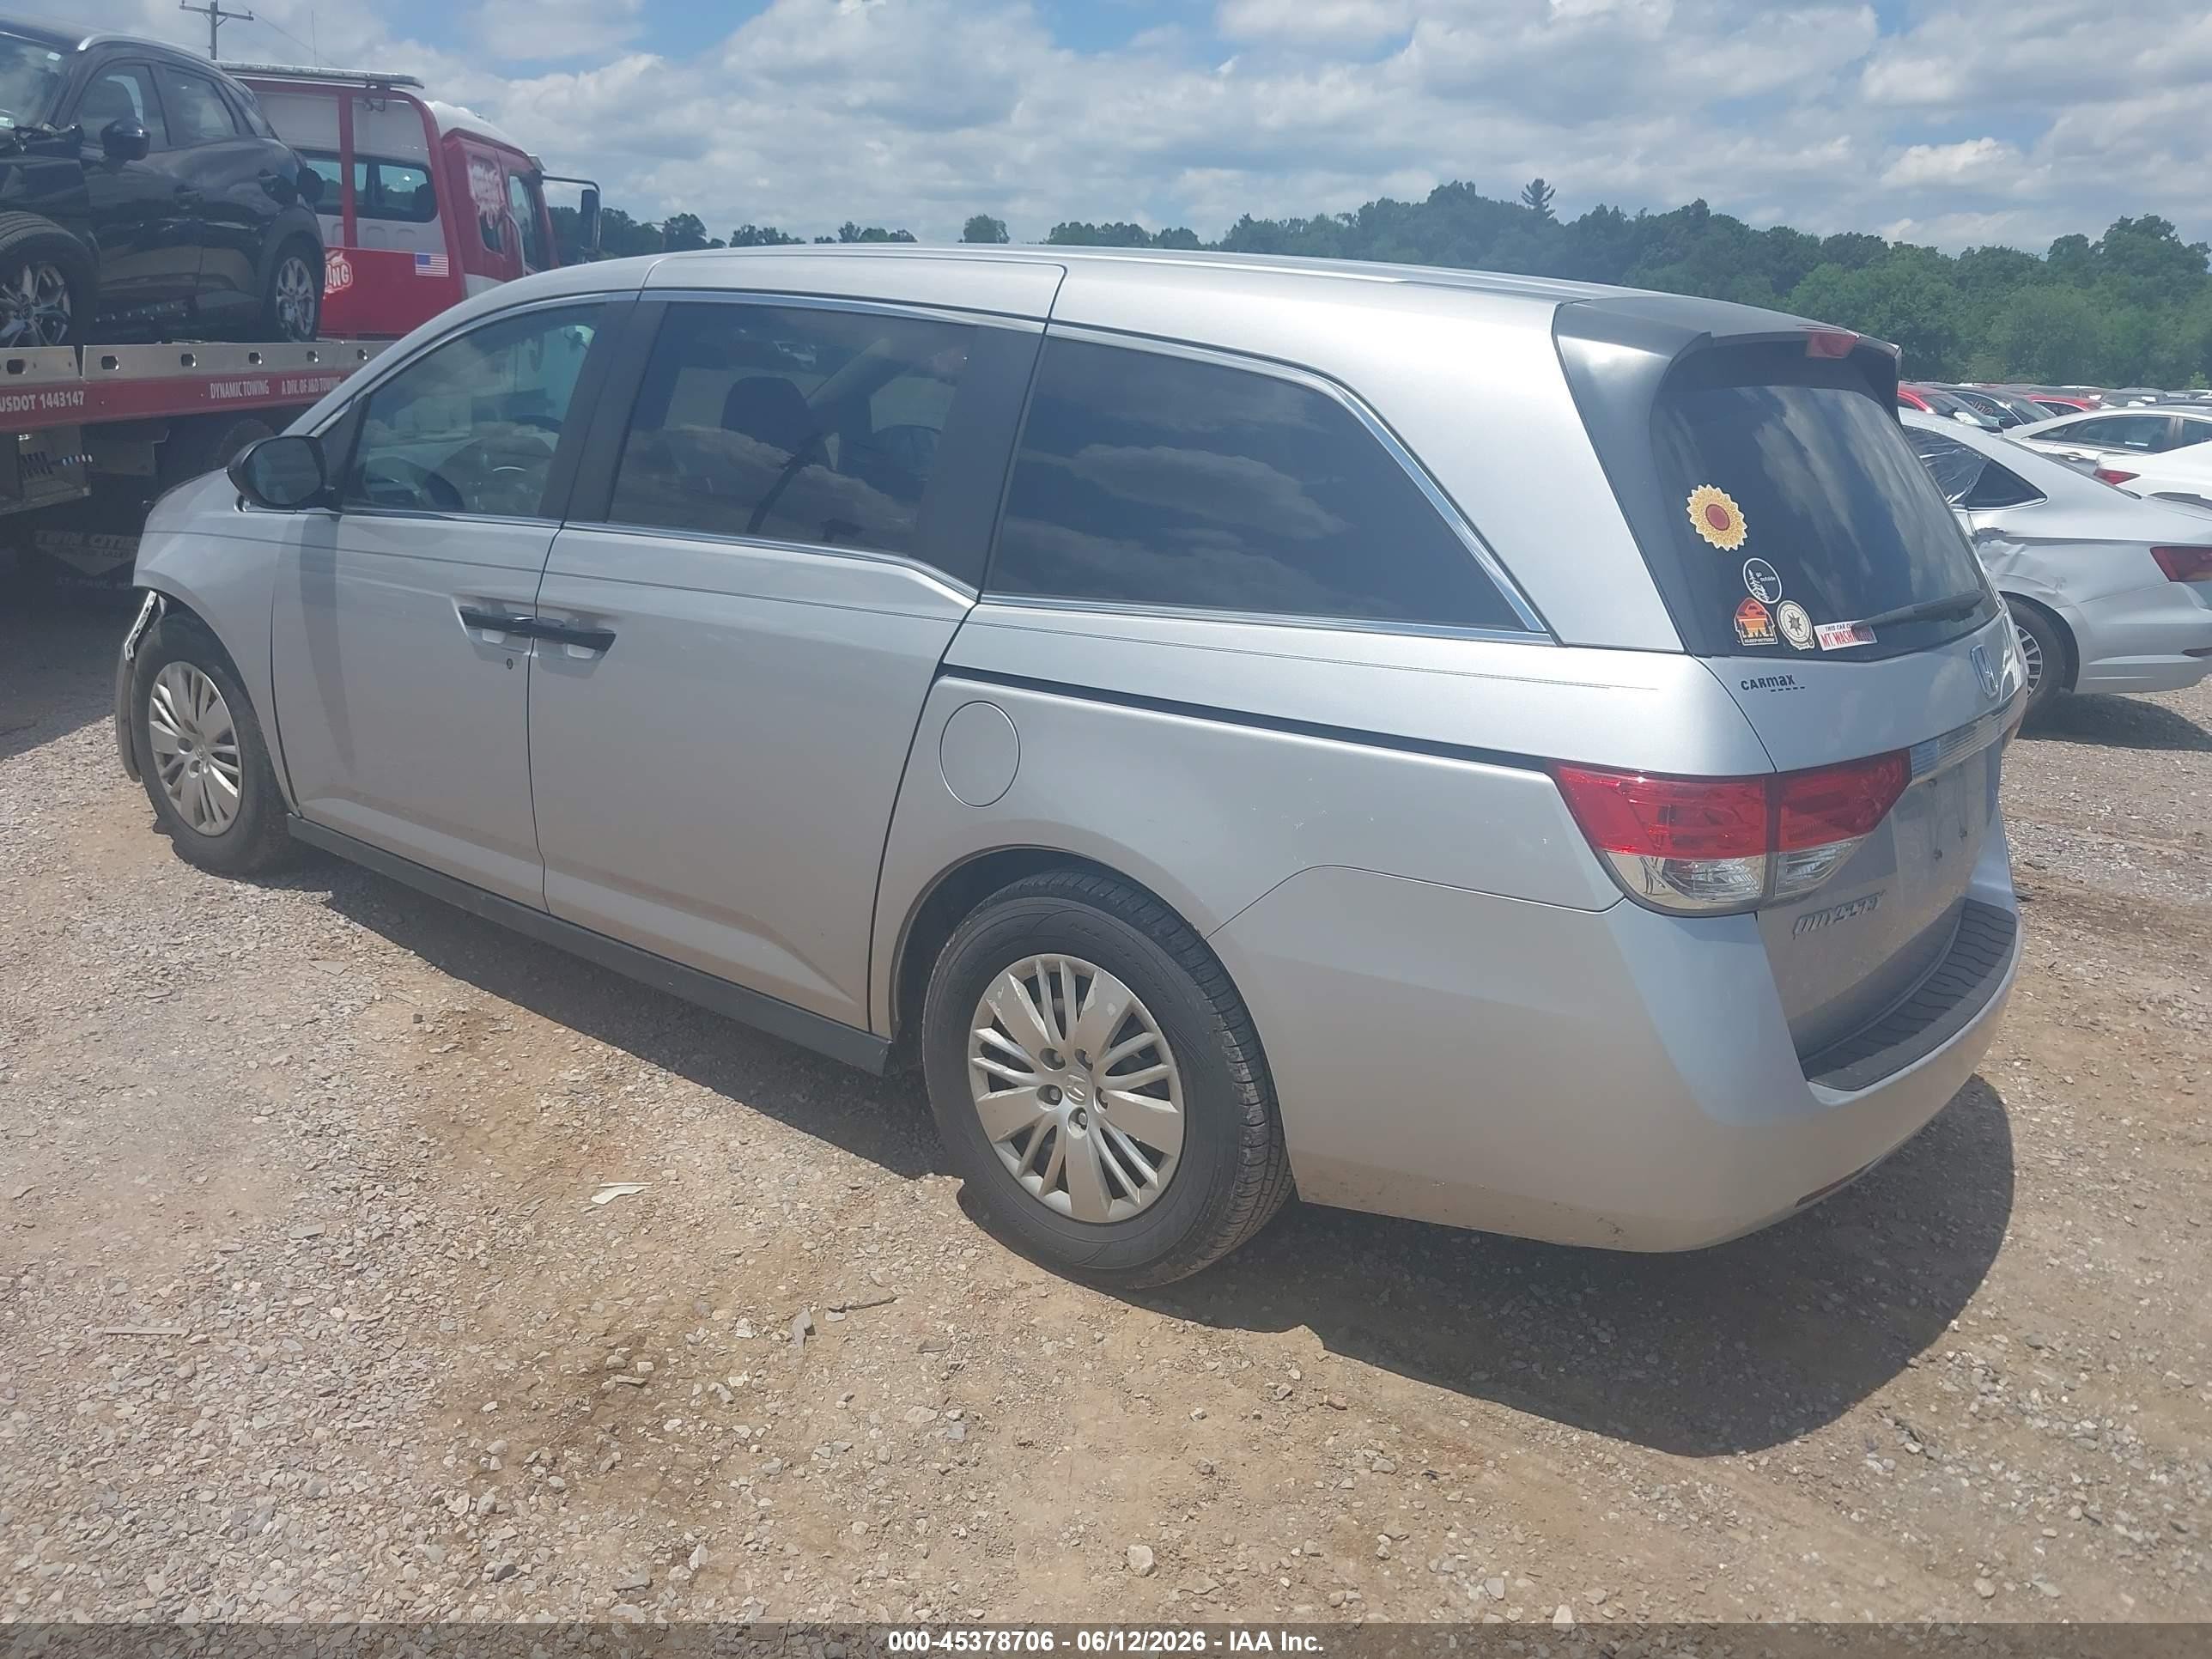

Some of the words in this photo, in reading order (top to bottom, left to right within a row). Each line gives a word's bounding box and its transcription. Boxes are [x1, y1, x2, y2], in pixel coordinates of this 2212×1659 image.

[210, 381, 242, 399] DYNAMIC
[243, 380, 270, 396] TOWING
[282, 380, 287, 395] A
[0, 394, 36, 412] USDOT
[40, 390, 84, 409] 1443147
